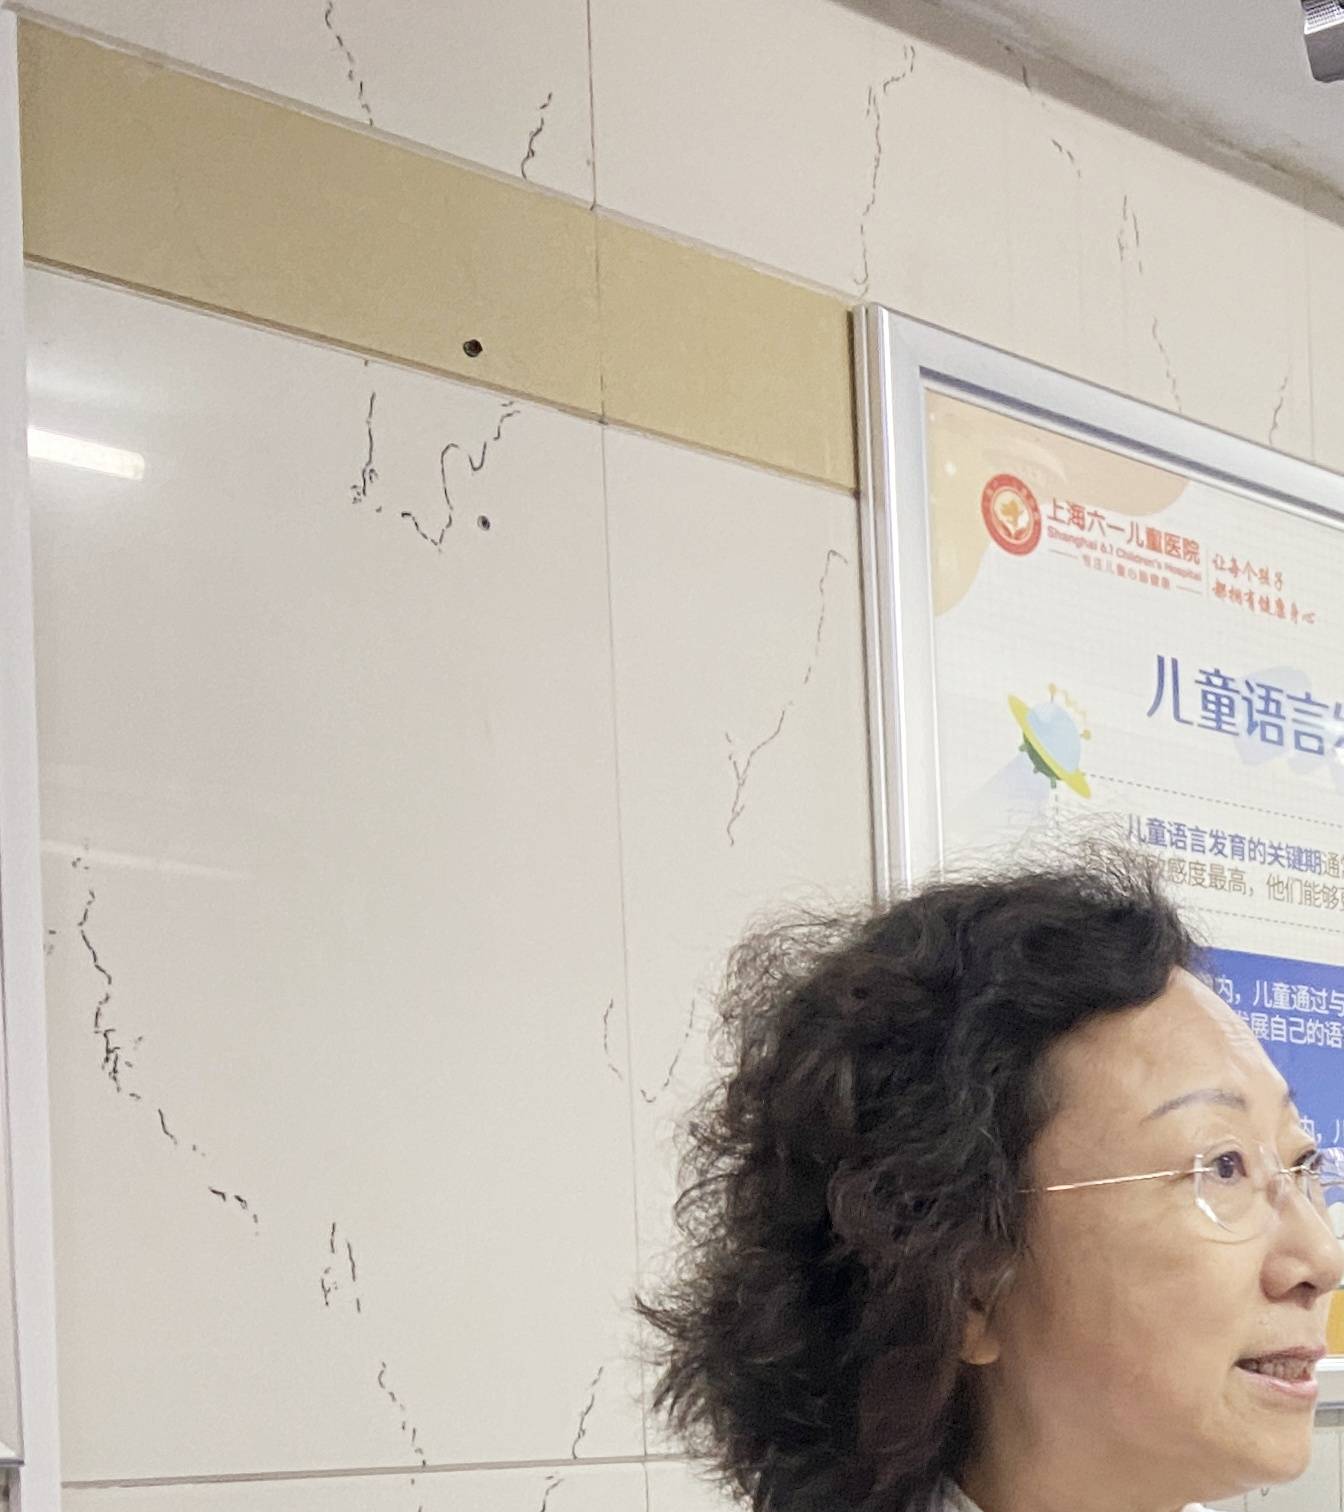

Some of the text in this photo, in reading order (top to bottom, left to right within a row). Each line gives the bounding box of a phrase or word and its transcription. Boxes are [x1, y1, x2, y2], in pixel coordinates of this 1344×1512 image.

[1047, 497, 1200, 565] 上海六一儿童医院
[1047, 525, 1098, 551] Shanghai
